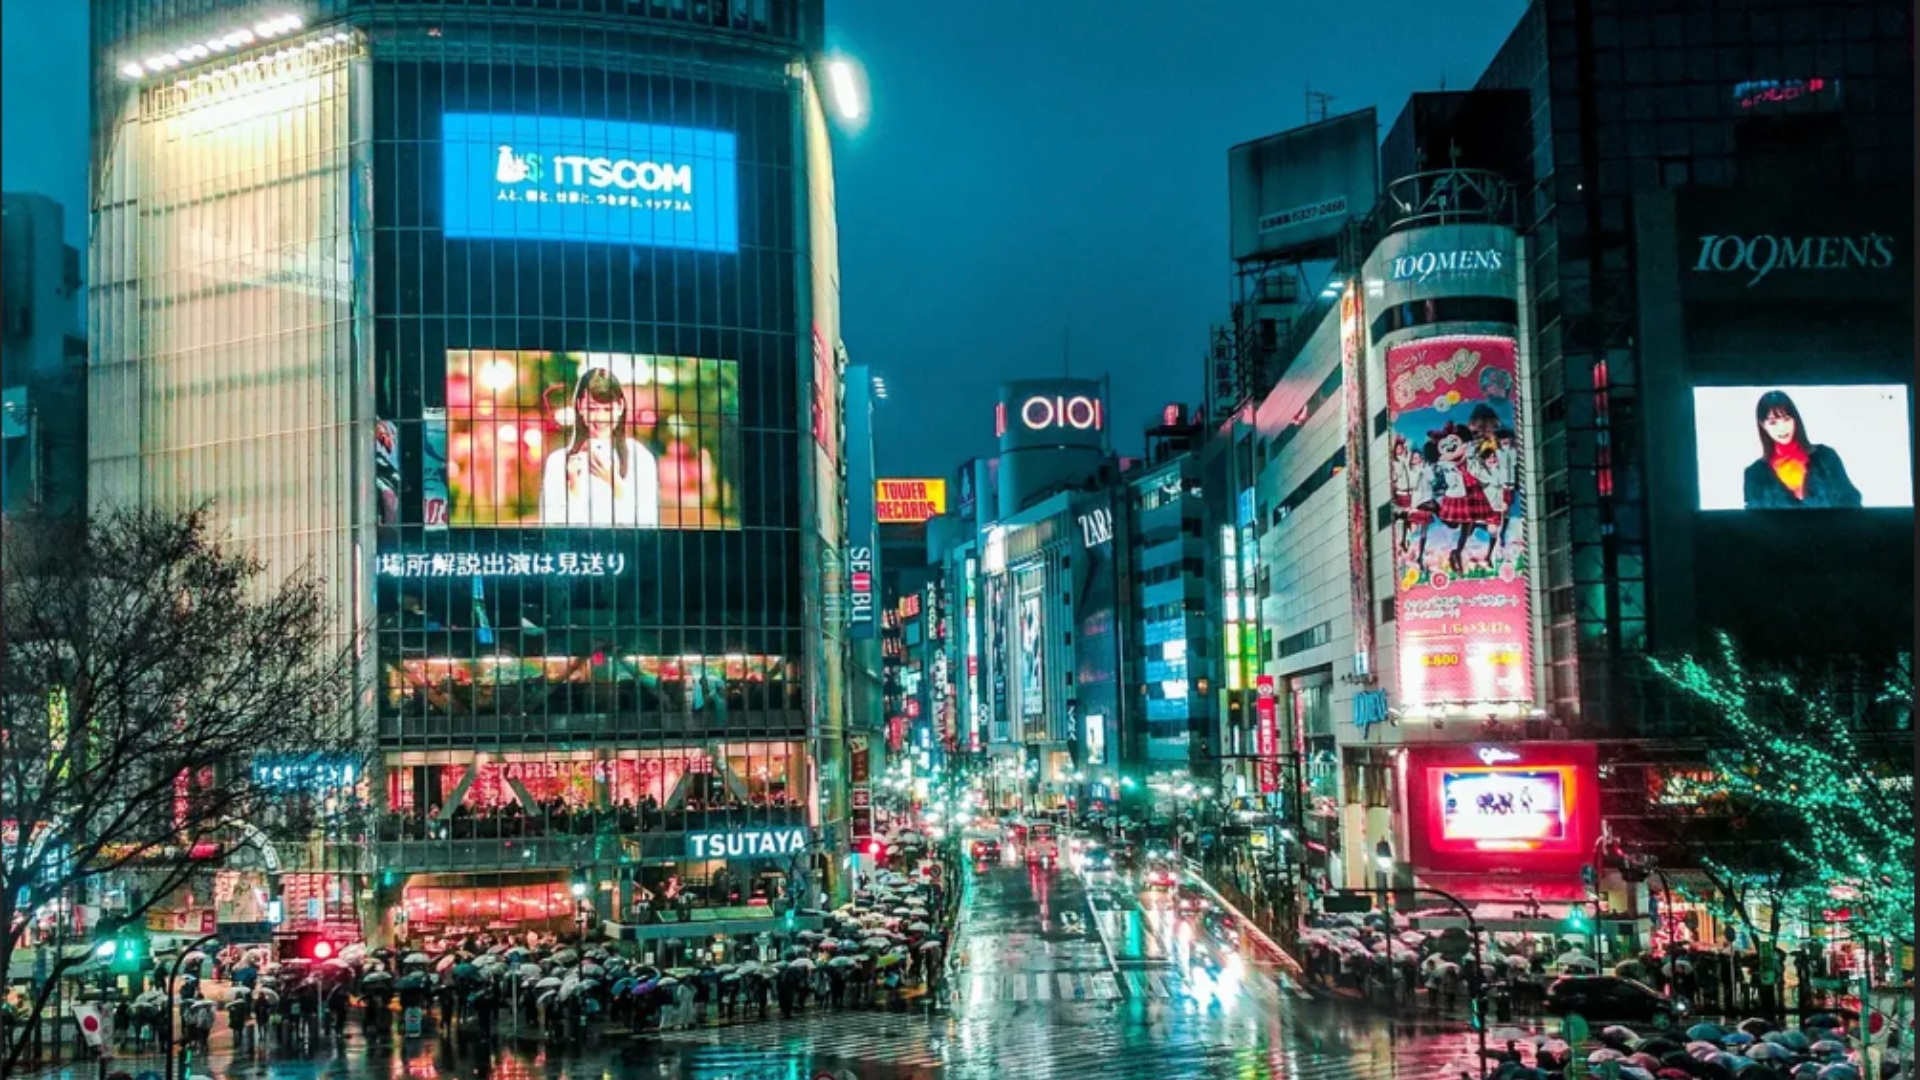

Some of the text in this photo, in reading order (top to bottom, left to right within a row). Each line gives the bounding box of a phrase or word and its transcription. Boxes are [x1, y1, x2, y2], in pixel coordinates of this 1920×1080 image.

[881, 482, 927, 500] TOWER
[876, 501, 936, 519] RECORDS
[376, 552, 625, 577] 場所解説出演は見送り
[479, 755, 713, 780] STARBUCKS COFFEE
[691, 829, 807, 857] TSUTAYA
